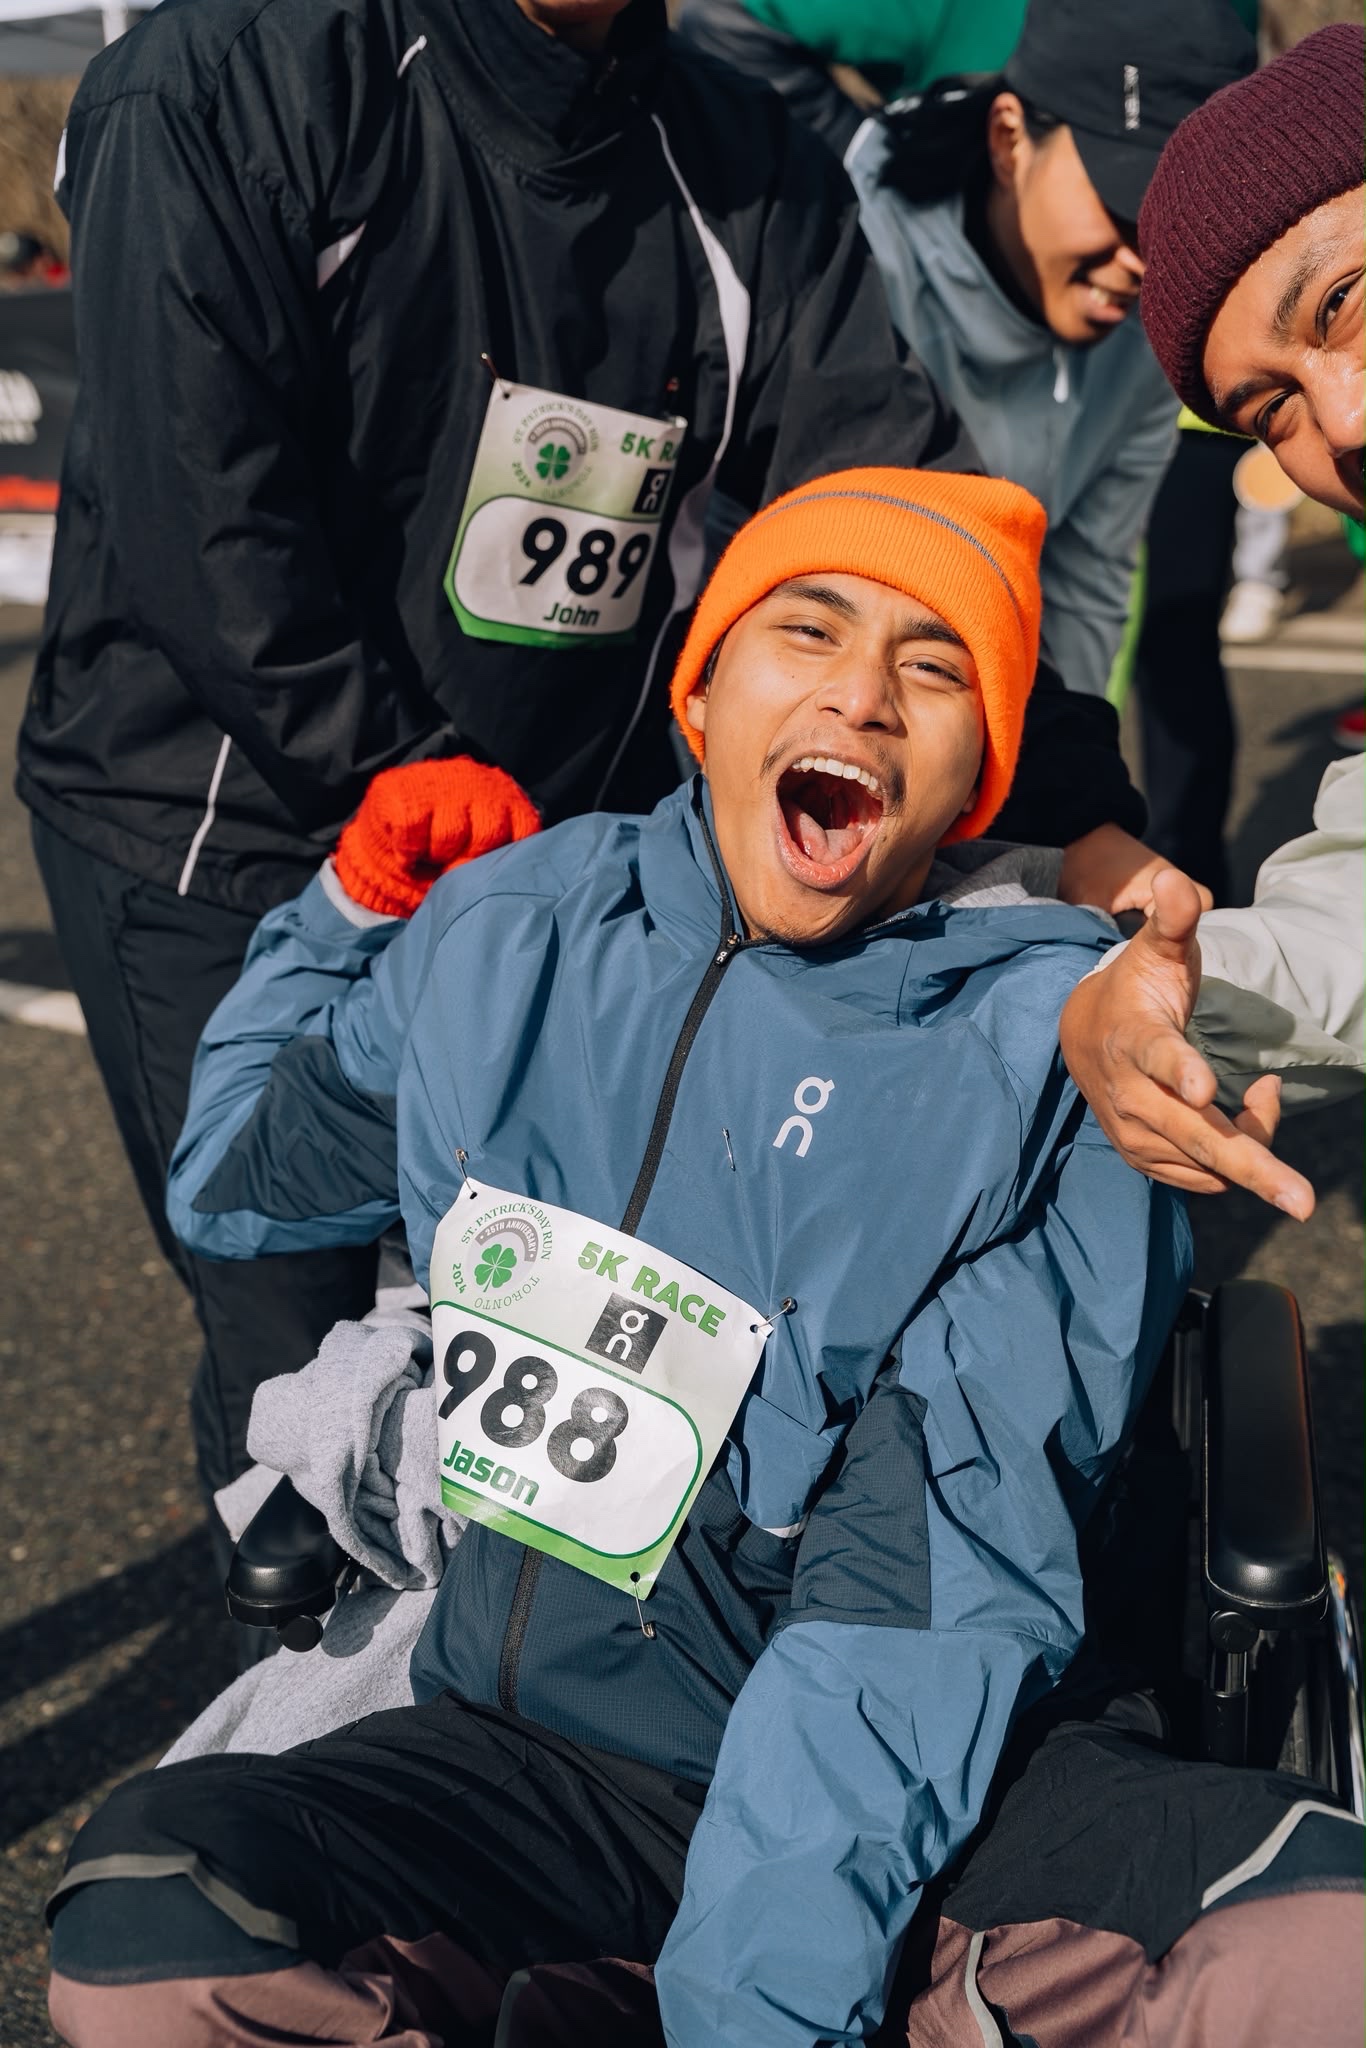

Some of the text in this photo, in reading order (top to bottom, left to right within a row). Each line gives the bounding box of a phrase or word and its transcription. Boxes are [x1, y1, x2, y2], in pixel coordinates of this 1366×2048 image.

[620, 431, 655, 459] 5K
[519, 517, 652, 599] 989
[543, 603, 601, 627] John
[461, 1202, 553, 1260] ST. PATRICK'S DAY RUN
[485, 1220, 536, 1252] 25TH ANNIVERSARY
[452, 1262, 467, 1294] 2024
[474, 1276, 540, 1310] TORONTO
[578, 1241, 727, 1338] 5K RACE
[438, 1330, 629, 1483] 988
[443, 1440, 540, 1506] Jason
